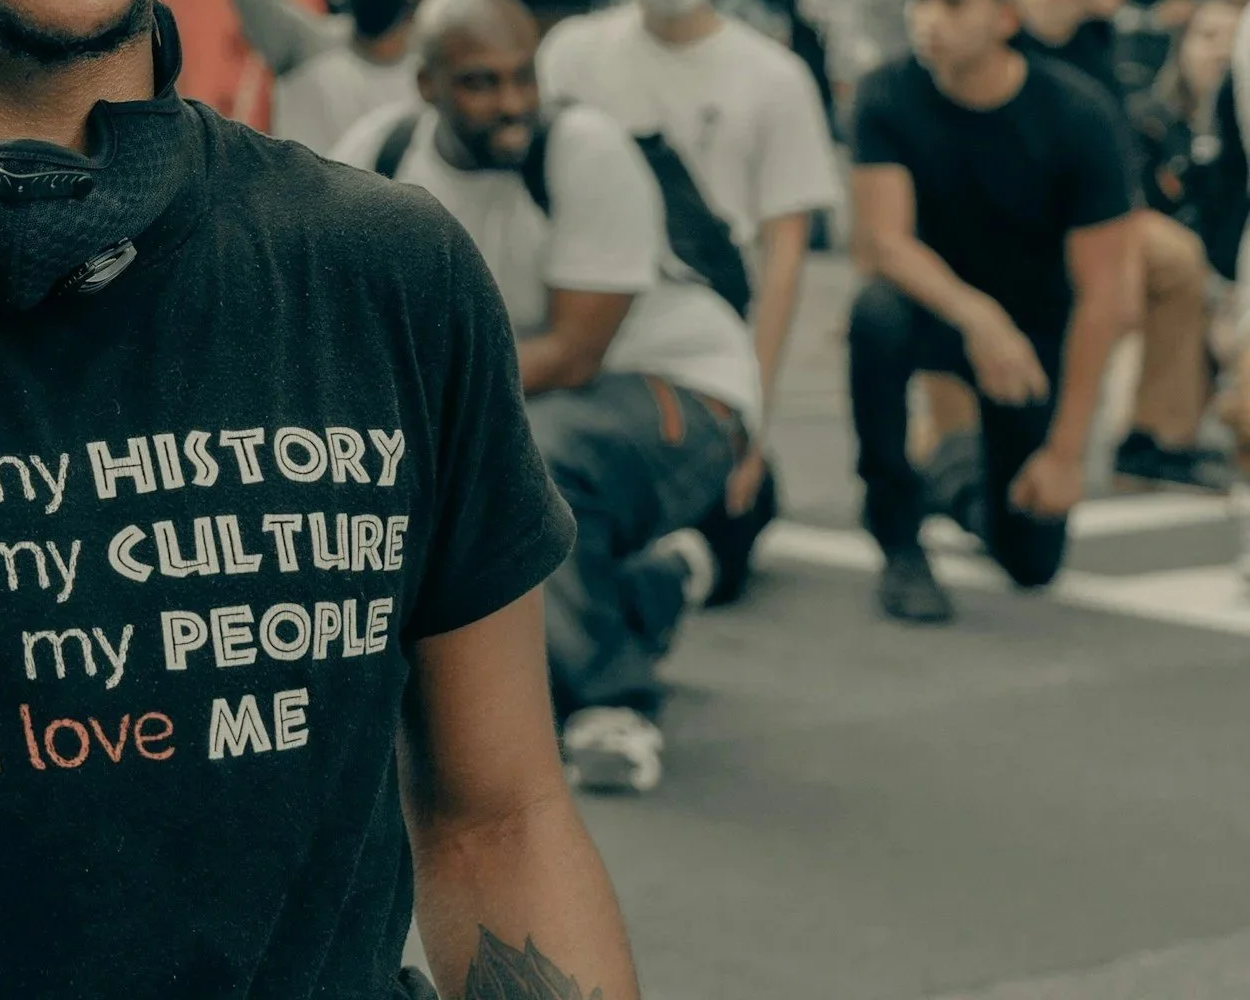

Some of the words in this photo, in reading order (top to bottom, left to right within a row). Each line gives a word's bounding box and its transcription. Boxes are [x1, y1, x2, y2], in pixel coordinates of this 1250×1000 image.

[85, 426, 406, 500] HISTORY
[107, 511, 410, 583] CULTURE
[21, 623, 135, 690] my
[160, 596, 394, 671] PEOPLE
[19, 703, 175, 770] love
[208, 687, 310, 761] ME
